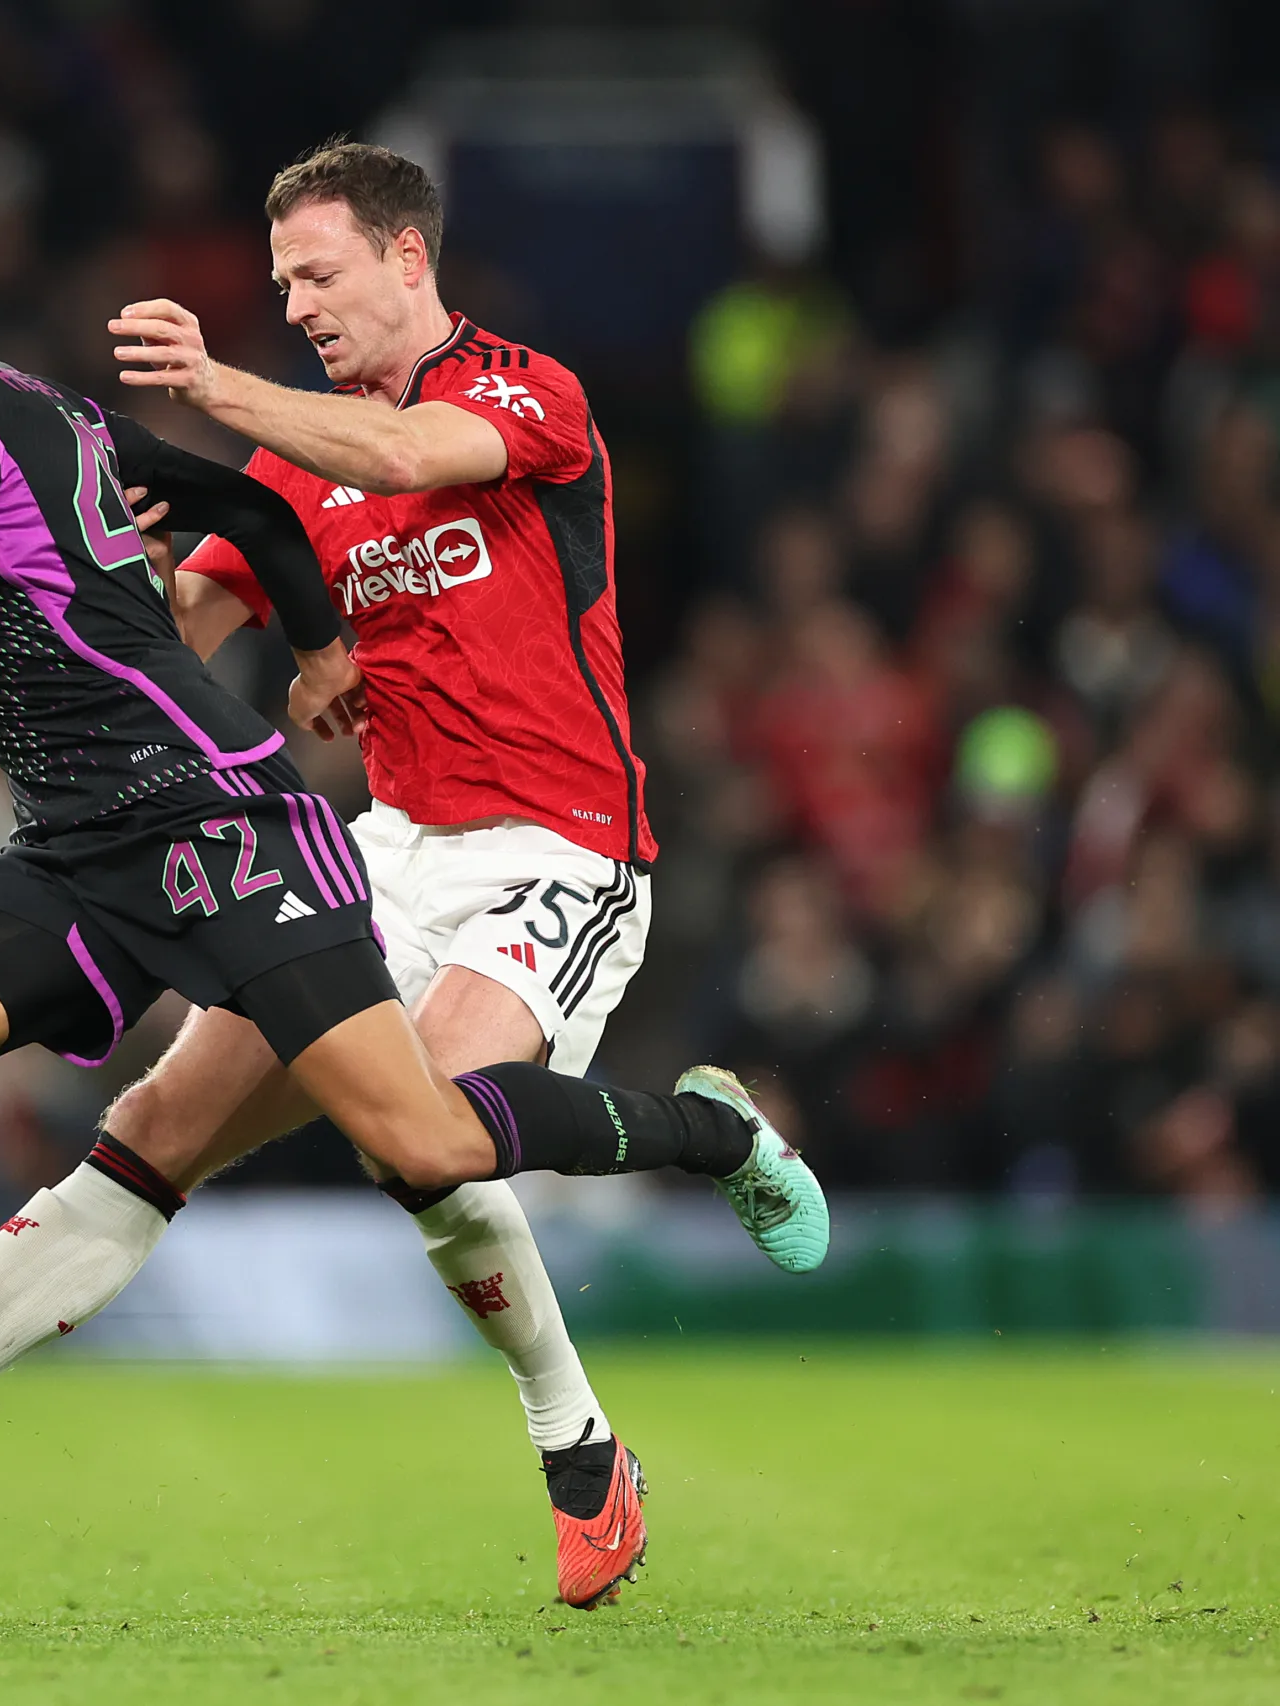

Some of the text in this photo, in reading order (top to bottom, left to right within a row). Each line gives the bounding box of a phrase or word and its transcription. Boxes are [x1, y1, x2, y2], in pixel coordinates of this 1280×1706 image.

[572, 808, 612, 826] HEAT.RDY
[162, 810, 284, 917] 42
[599, 1090, 628, 1162] BAYERN
